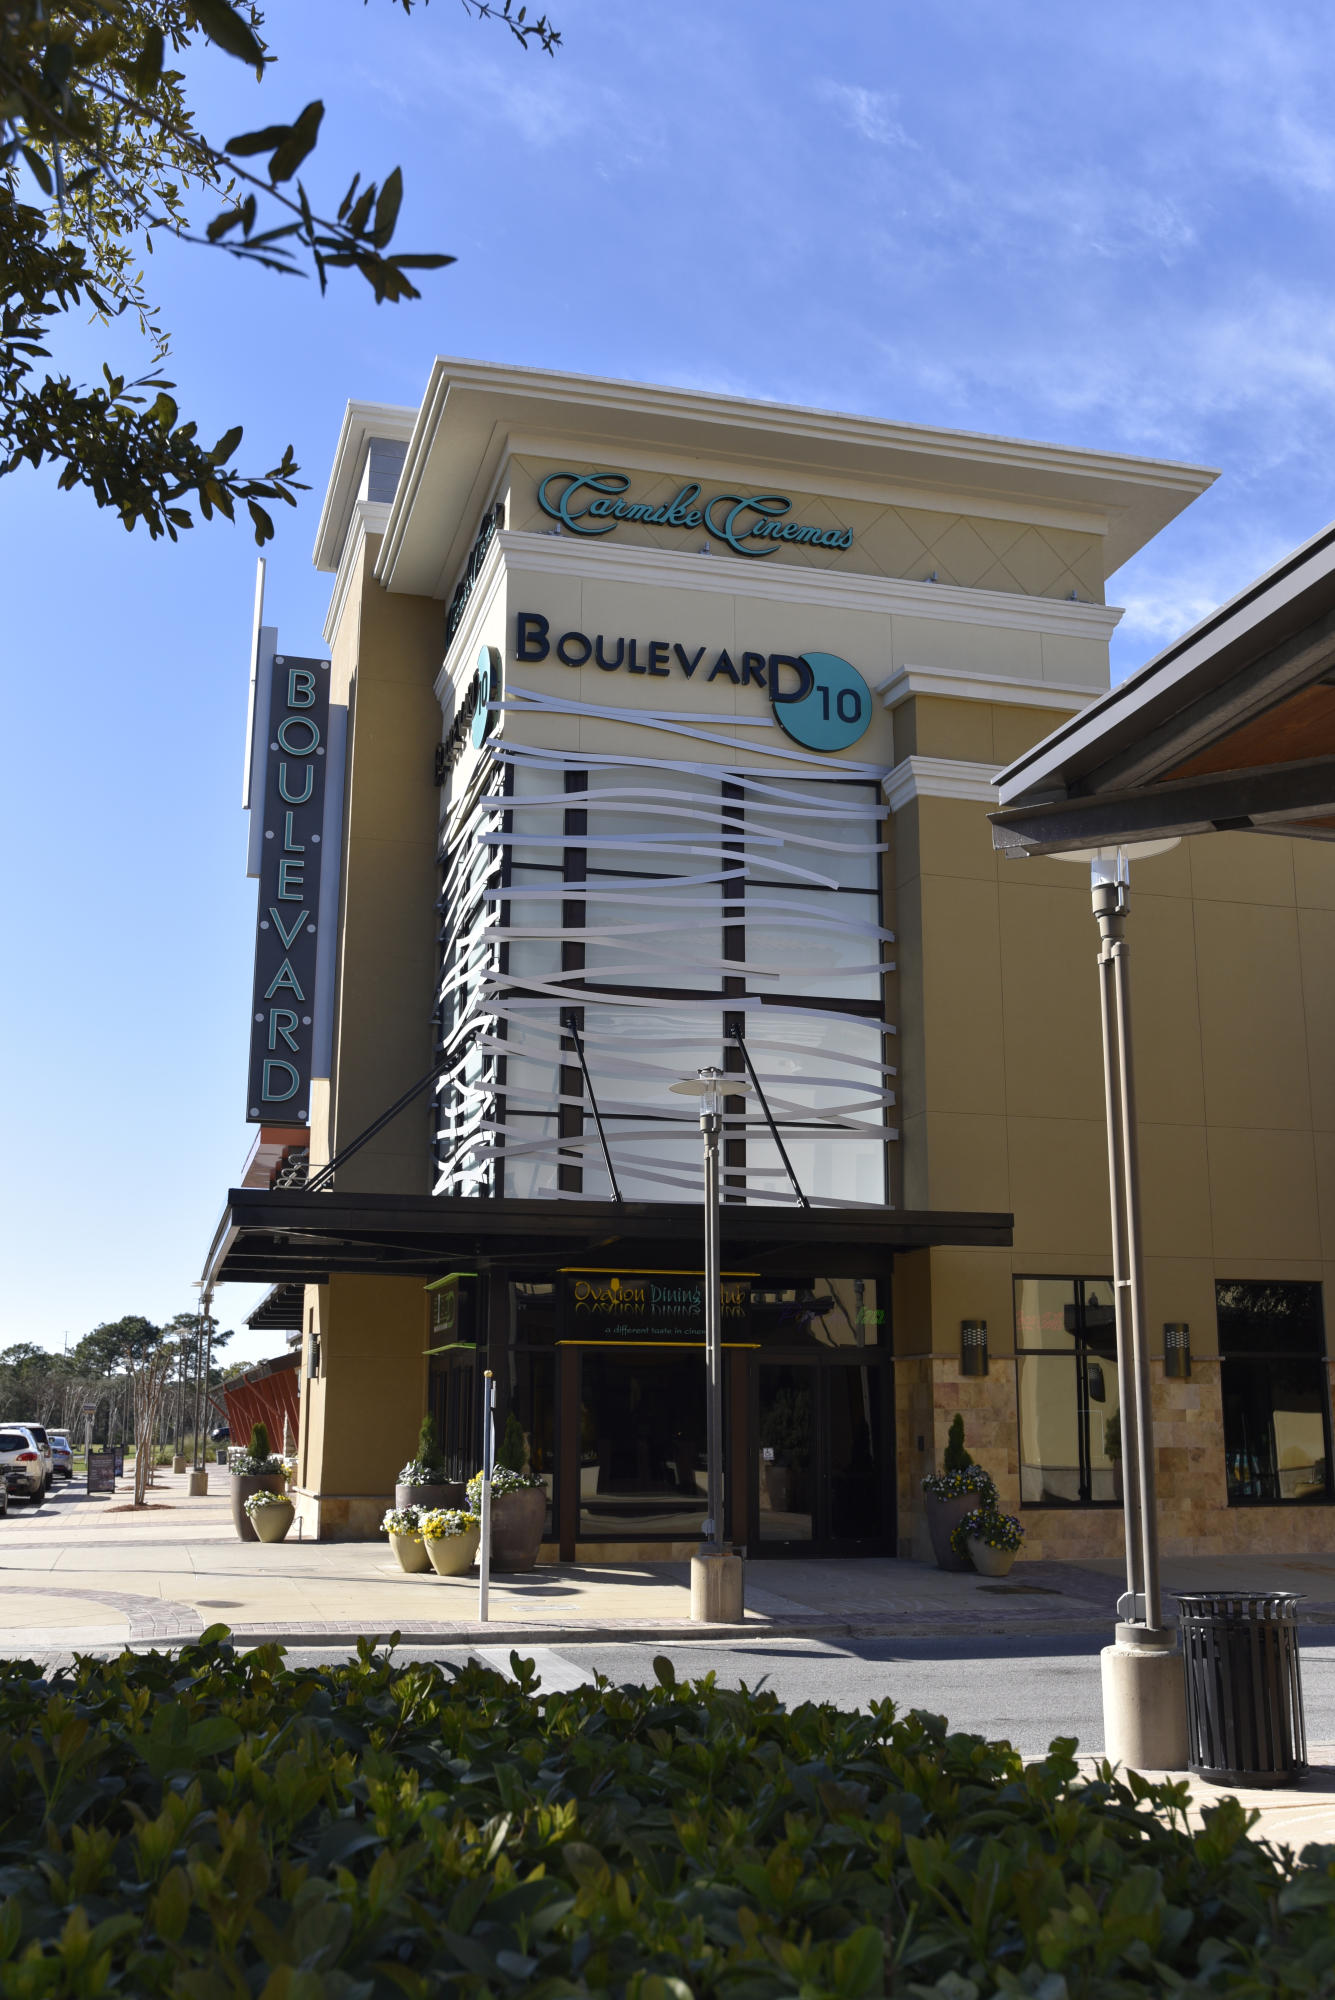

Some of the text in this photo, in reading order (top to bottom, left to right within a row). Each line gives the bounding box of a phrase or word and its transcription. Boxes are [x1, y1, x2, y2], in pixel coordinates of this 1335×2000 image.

[538, 471, 855, 557] Carmike Cinemas
[516, 611, 862, 724] BOULEVARD 10
[261, 668, 320, 1103] BOULEVARD
[574, 1277, 746, 1306] Ovation Dining lub
[613, 1324, 649, 1336] different
[651, 1327, 672, 1335] taste
[675, 1326, 682, 1335] in
